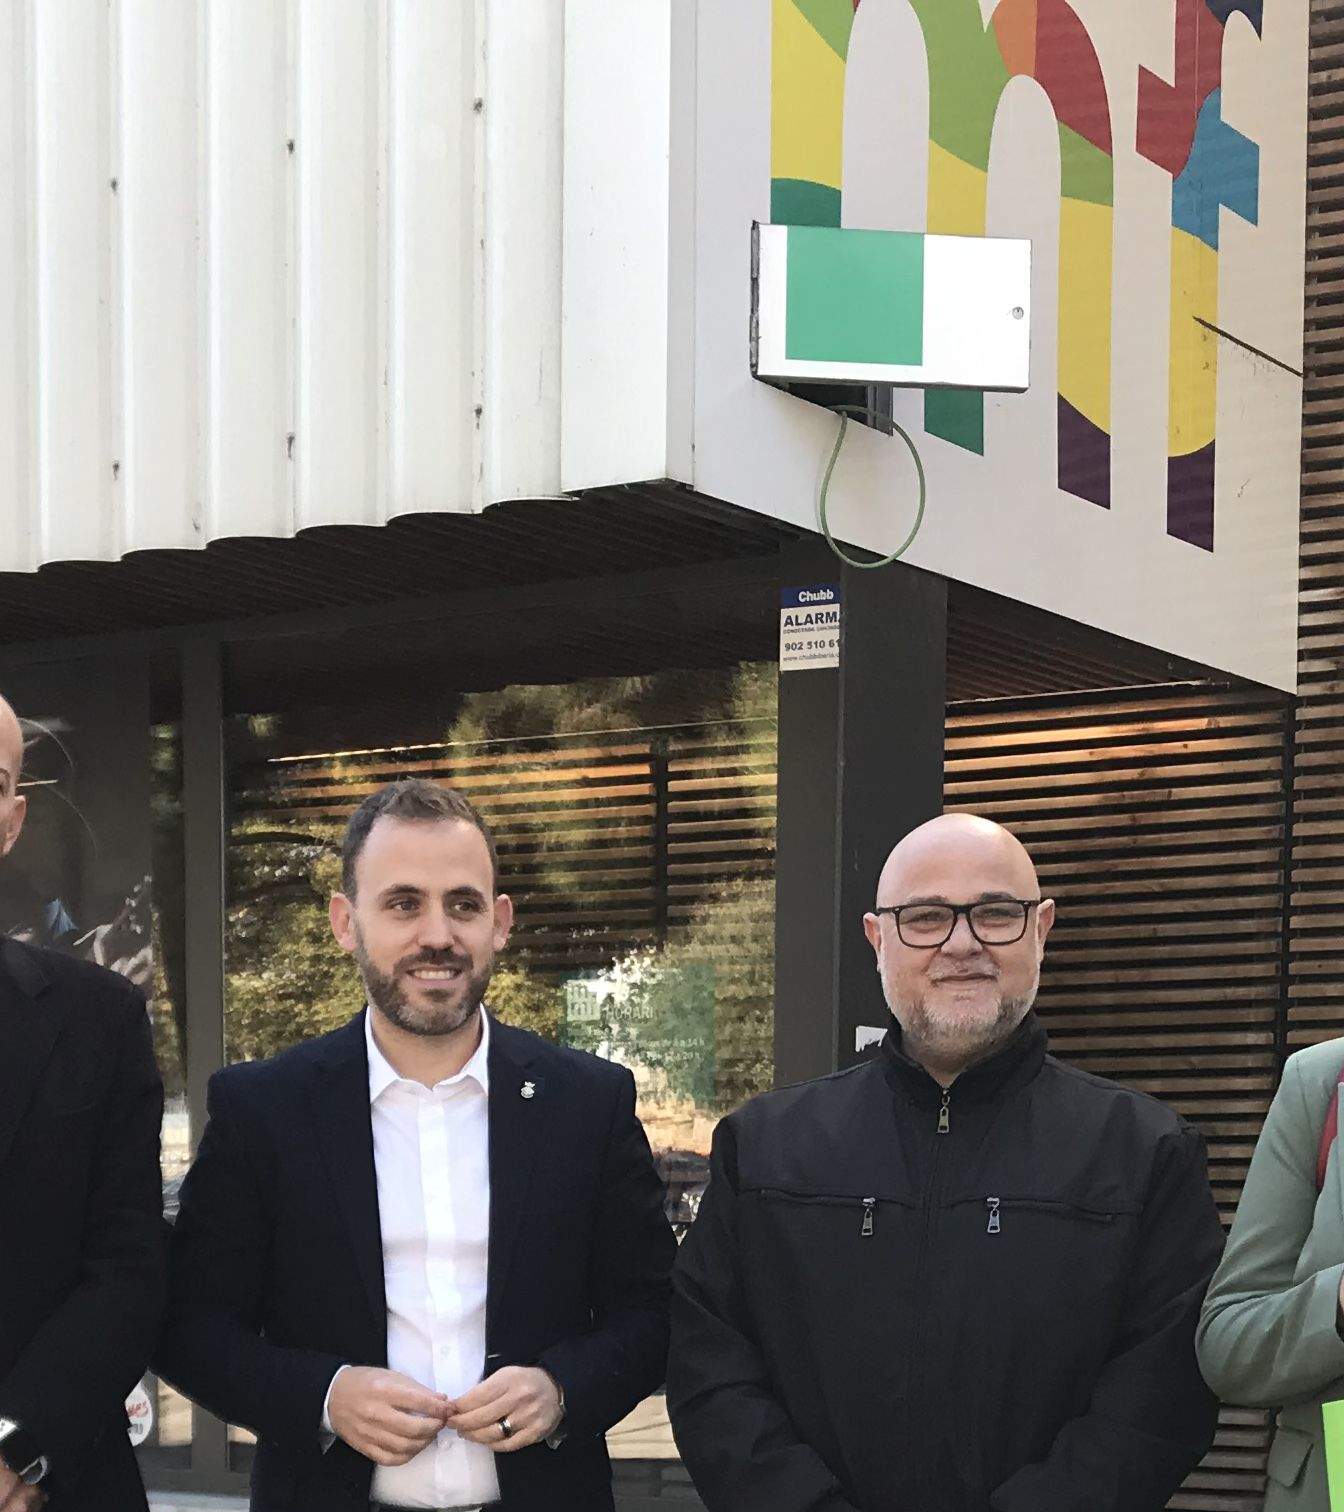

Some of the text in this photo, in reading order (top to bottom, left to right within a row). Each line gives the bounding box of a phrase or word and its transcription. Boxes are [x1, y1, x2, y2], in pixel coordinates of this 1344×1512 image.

[798, 589, 834, 602] Chubb
[785, 642, 803, 651] 902
[807, 640, 826, 650] 510
